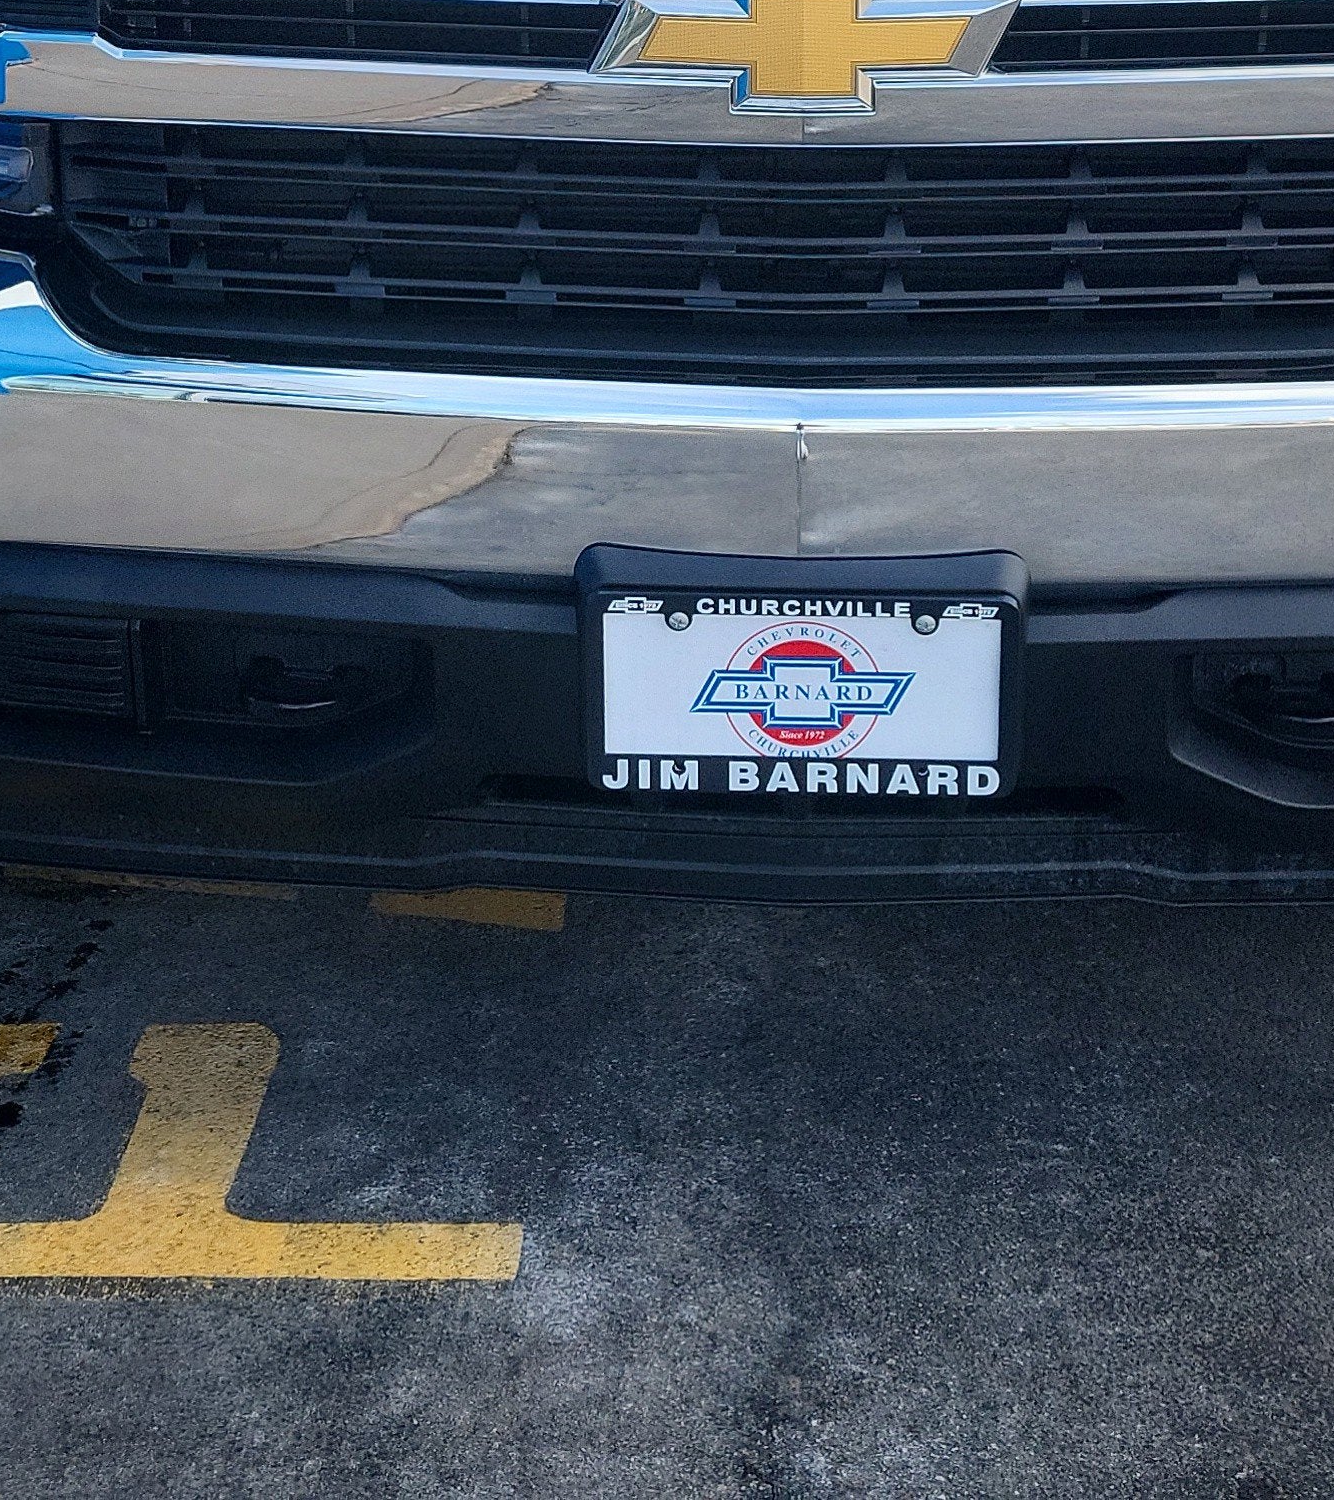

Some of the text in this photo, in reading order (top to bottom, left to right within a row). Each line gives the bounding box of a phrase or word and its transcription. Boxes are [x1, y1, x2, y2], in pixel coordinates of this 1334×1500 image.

[696, 597, 912, 619] CHURCHVILLE
[747, 626, 862, 658] CHEVROLET
[735, 683, 873, 701] BARNARD
[779, 730, 826, 740] Since 1972
[602, 759, 1001, 796] JIM BARNARD
